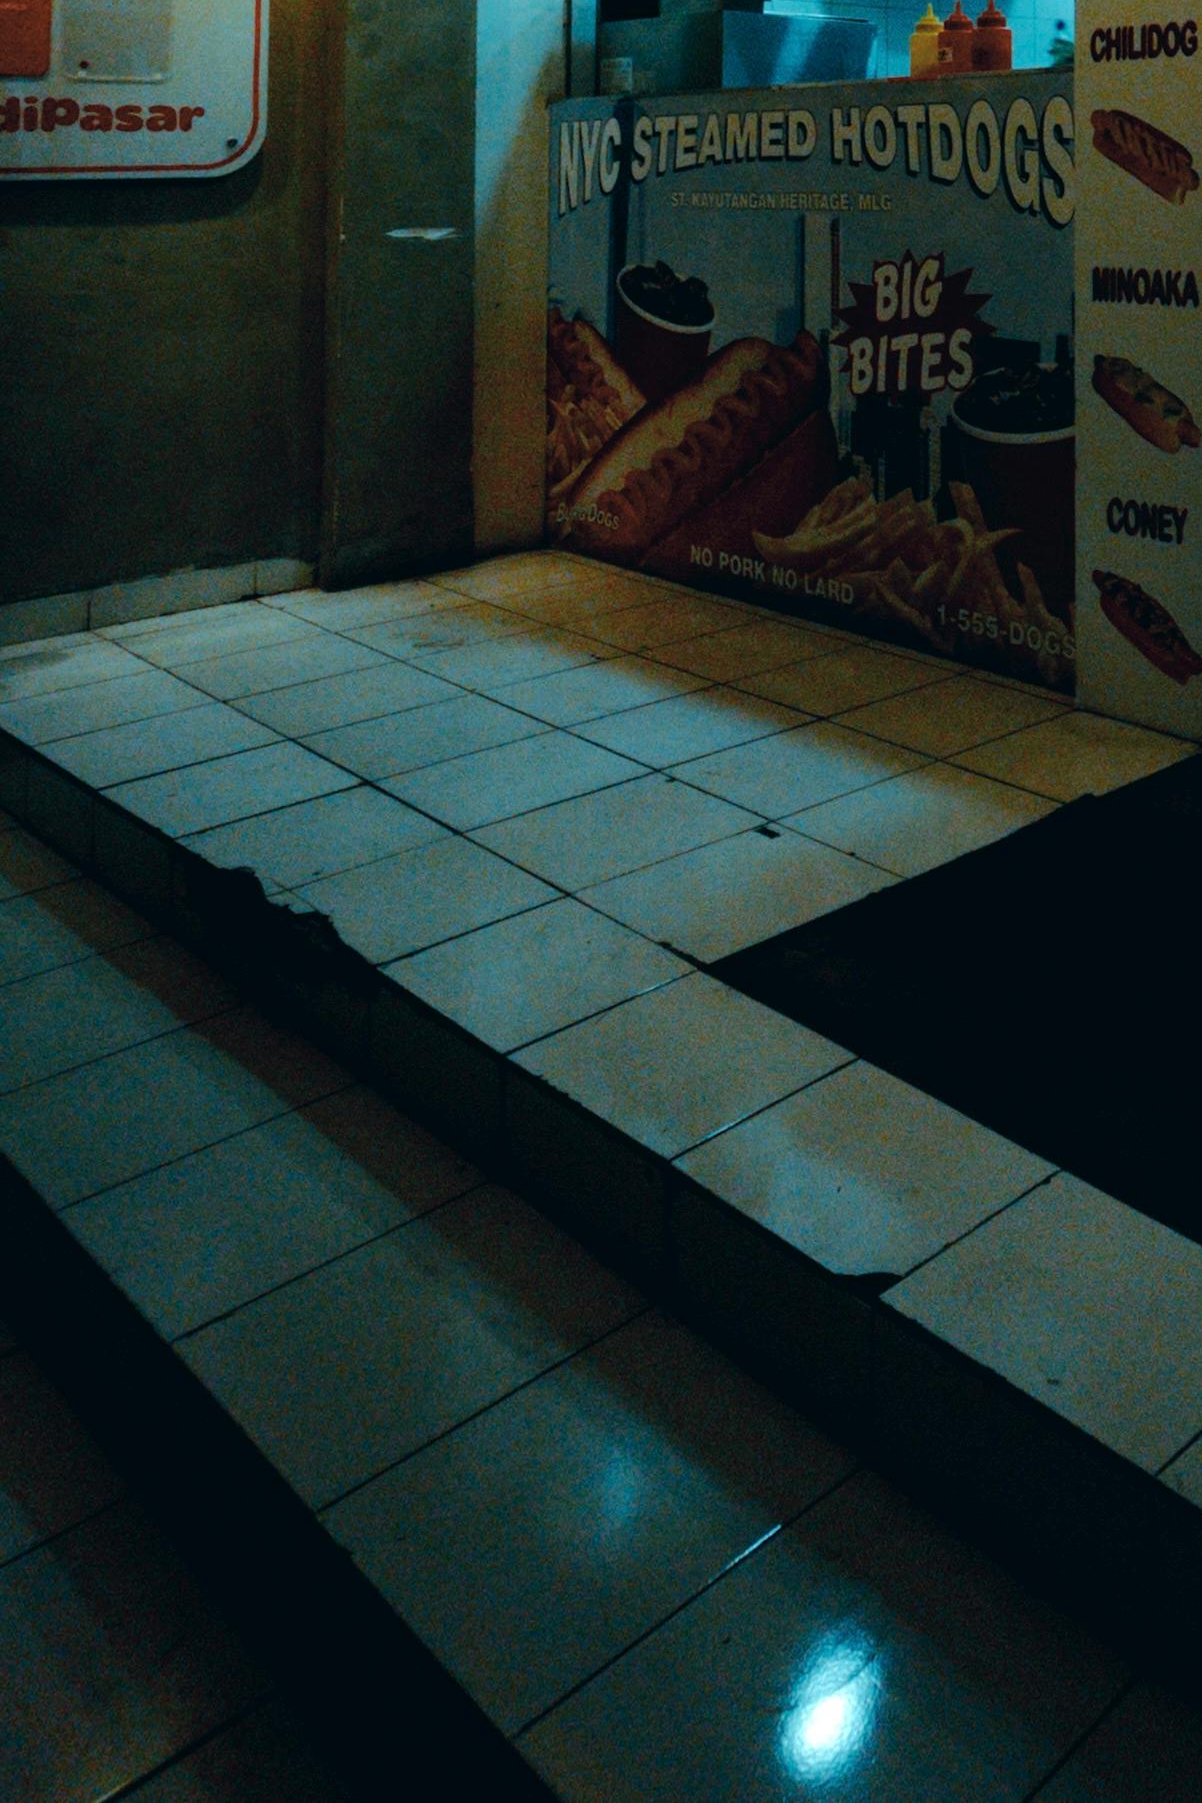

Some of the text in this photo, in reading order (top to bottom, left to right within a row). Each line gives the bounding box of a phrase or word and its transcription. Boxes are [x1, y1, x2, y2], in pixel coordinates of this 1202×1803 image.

[1090, 20, 1198, 63] CHILIDOG
[558, 95, 1076, 230] NYC STEAMED HOTDOGS
[858, 194, 892, 211] MLG
[872, 255, 944, 324] BIG
[1092, 266, 1199, 308] MINOAKA
[848, 327, 976, 396] BITES
[1107, 498, 1189, 545] CONEY
[690, 544, 855, 606] NO PORK NO LARD
